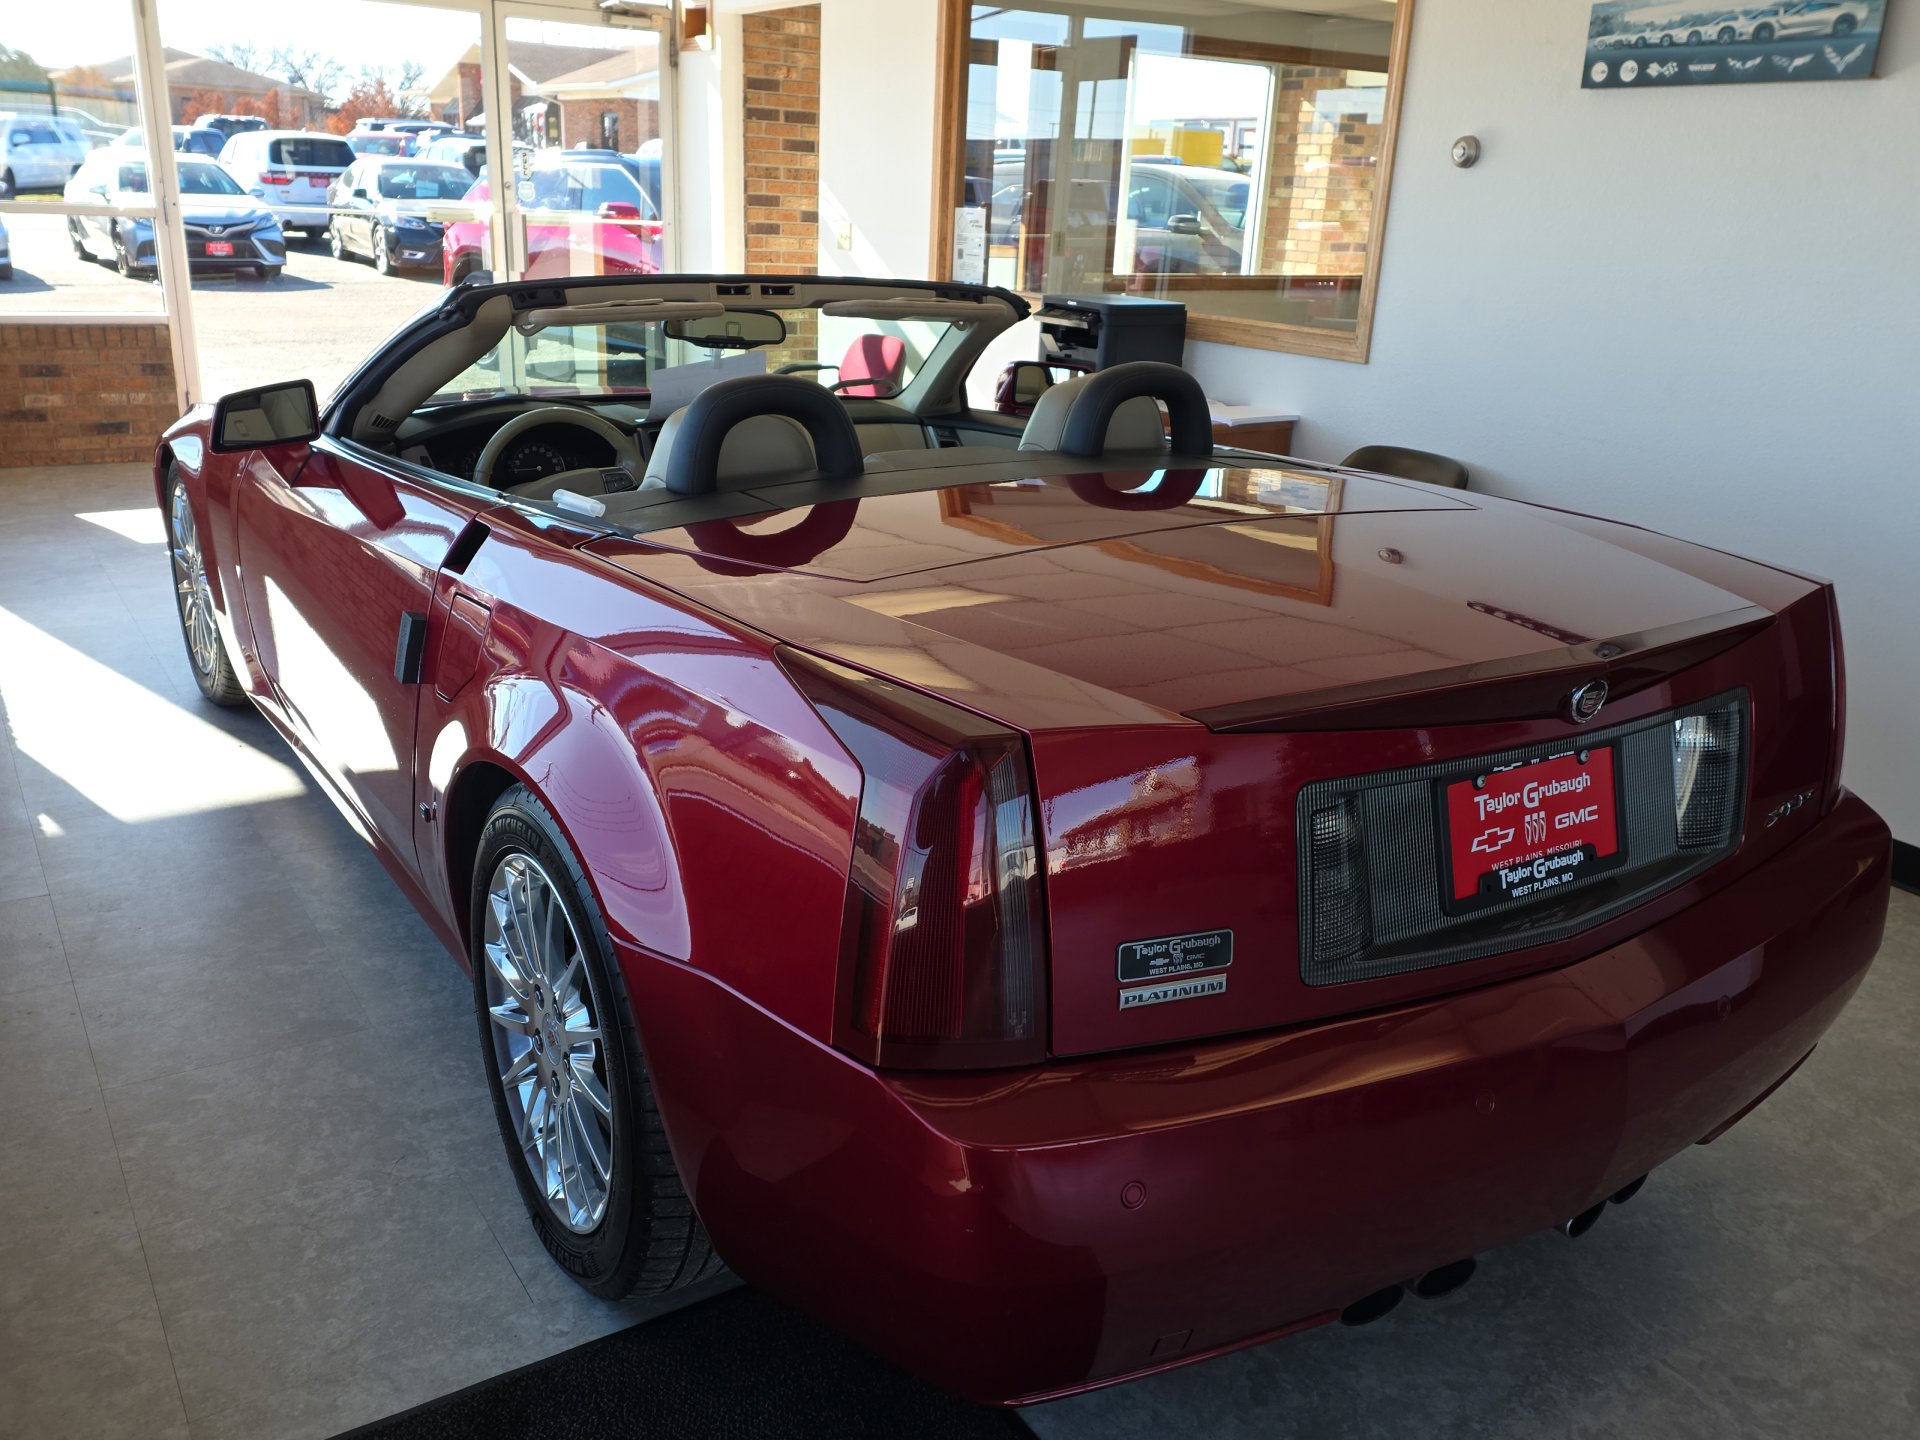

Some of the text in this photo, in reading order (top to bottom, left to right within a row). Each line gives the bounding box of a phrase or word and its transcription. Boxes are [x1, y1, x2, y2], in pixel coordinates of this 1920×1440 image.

[1474, 772, 1591, 821] Taylor Grubaugh
[1554, 804, 1599, 830] GMC
[495, 817, 540, 850] MICHELIN
[1491, 858, 1514, 872] WEST
[1546, 839, 1583, 856] MISSOURI
[1499, 850, 1584, 890] Taylor Grubaugh
[1511, 883, 1533, 898] WEST
[1562, 871, 1574, 883] MO
[1132, 935, 1221, 960] Taylor Grubaugh
[1186, 952, 1206, 961] GMC
[1149, 966, 1168, 976] WEST
[1124, 981, 1224, 1005] PLATINUM
